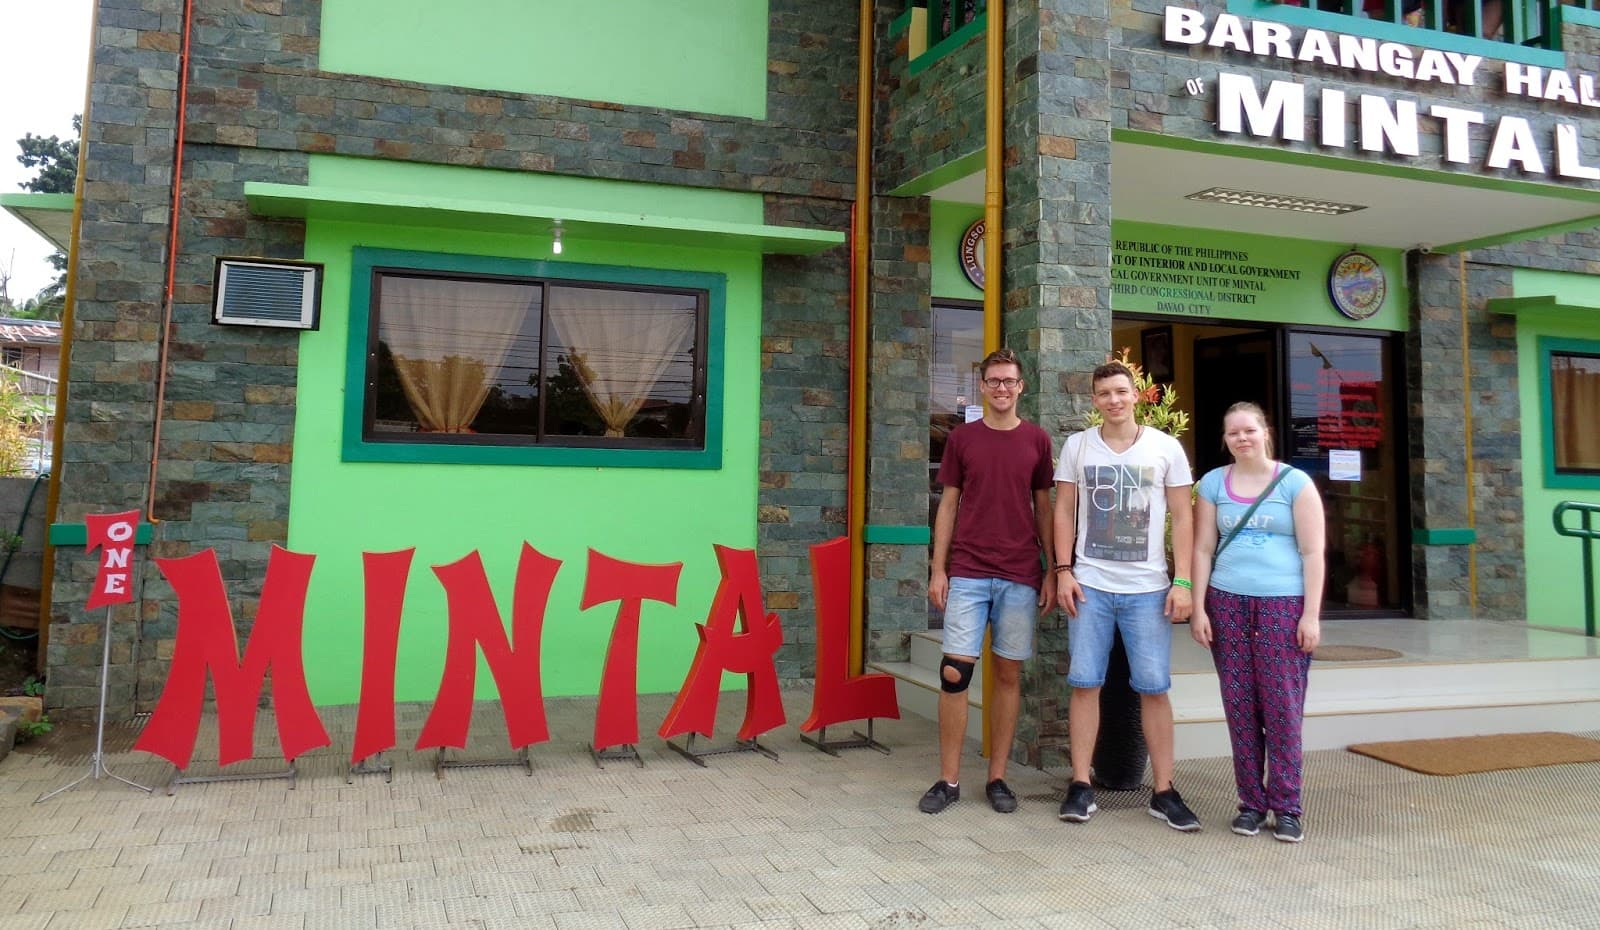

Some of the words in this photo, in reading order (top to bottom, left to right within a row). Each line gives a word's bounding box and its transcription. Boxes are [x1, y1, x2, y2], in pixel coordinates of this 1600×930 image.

[1165, 6, 1482, 86] BARANGAY
[1186, 77, 1204, 96] OF
[1218, 72, 1600, 180] MINTAL
[965, 224, 984, 271] LUNGSO
[1115, 240, 1160, 253] REPUBLIC
[1161, 244, 1173, 254] OF
[1175, 245, 1193, 257] THE
[1195, 246, 1249, 261] PHILIPPINES
[1110, 268, 1129, 279] CAL
[1131, 270, 1194, 285] GOVERNMENT
[1196, 275, 1218, 287] UNIT
[1218, 278, 1231, 288] OF
[1232, 279, 1267, 291] MINTAL
[1124, 255, 1138, 267] OF
[1139, 256, 1185, 270] INTERIOR
[1188, 261, 1208, 272] AND
[1209, 262, 1239, 274] LOCAL
[1239, 265, 1301, 280] GOVERNMENT
[1140, 285, 1215, 300] CONGRESSIONAL
[1217, 292, 1257, 304] DISTRICT
[1157, 301, 1184, 313] DAVAO
[1188, 304, 1212, 315] CITY
[104, 521, 133, 594] ONE
[132, 535, 900, 772] MINTAL
